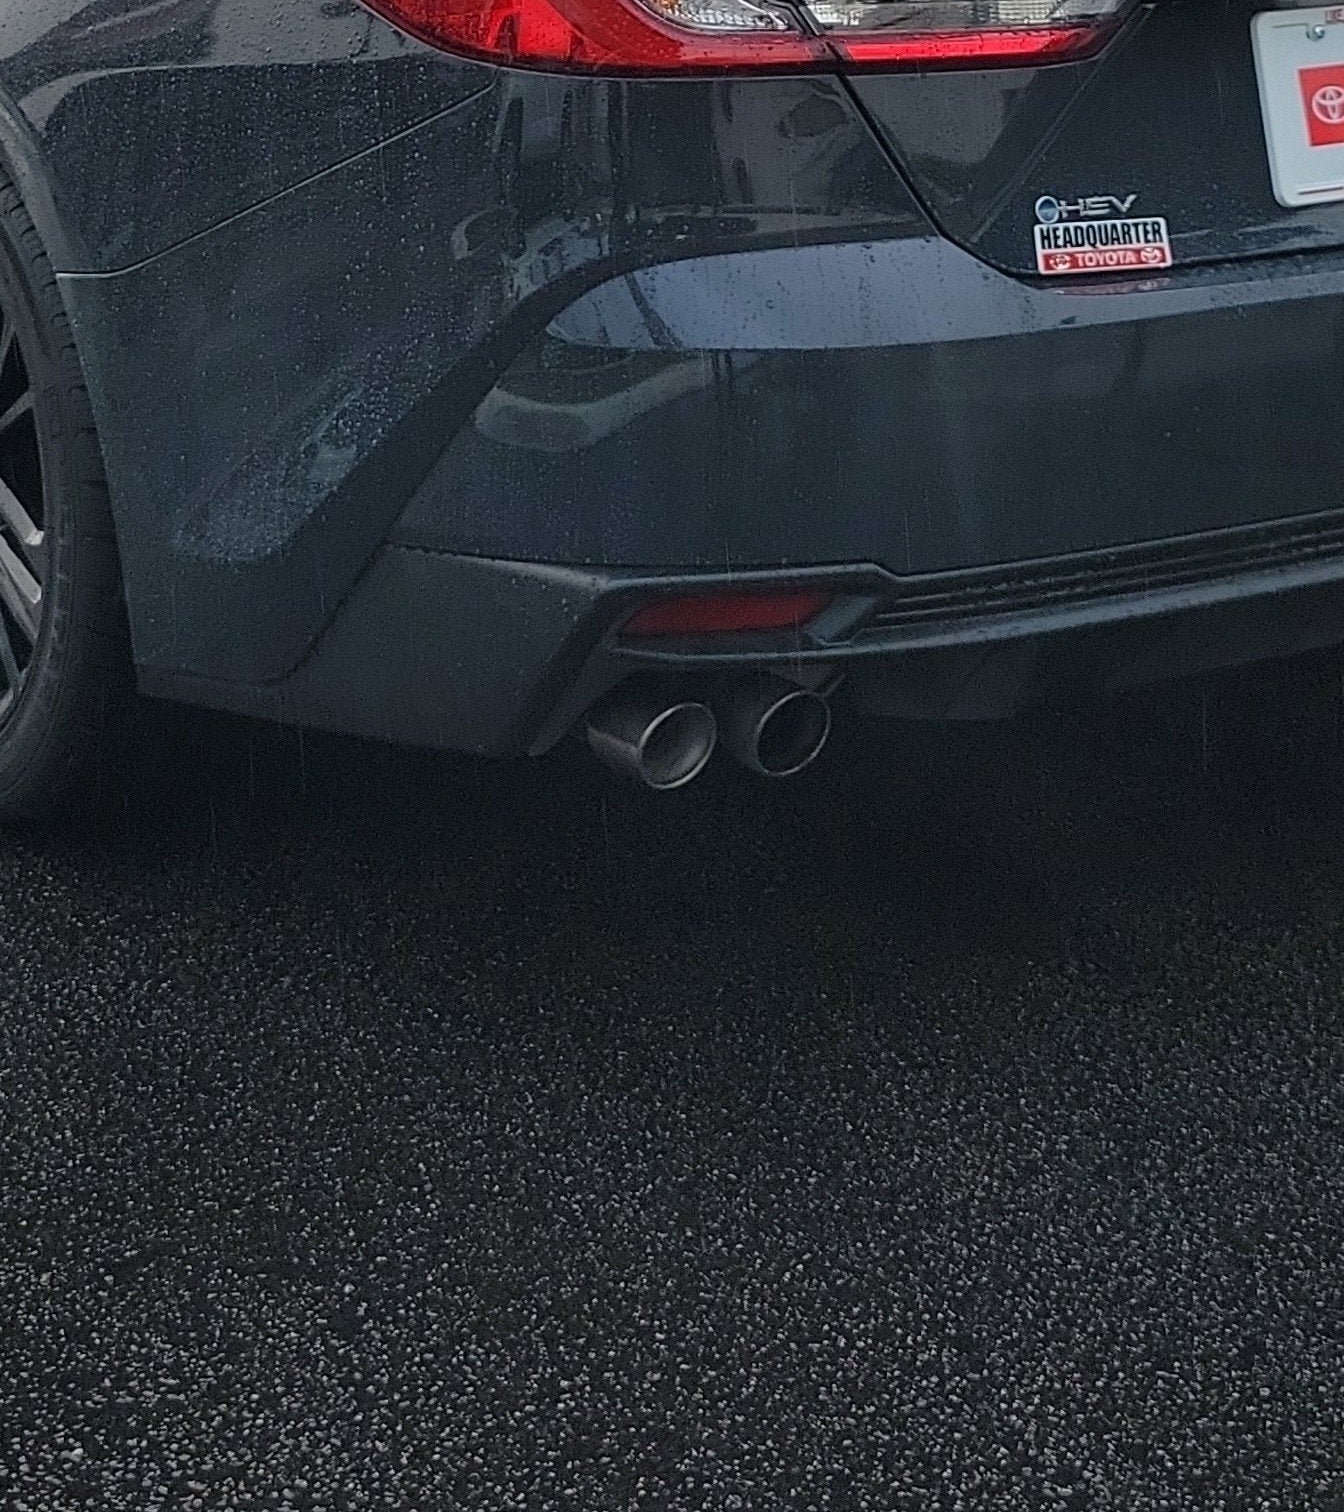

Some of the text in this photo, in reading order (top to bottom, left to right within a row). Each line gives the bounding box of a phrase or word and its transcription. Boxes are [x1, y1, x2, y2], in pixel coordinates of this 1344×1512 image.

[1059, 194, 1137, 219] HEV
[1039, 220, 1164, 250] HEADQUARTER
[1074, 249, 1137, 267] TOYOTA
